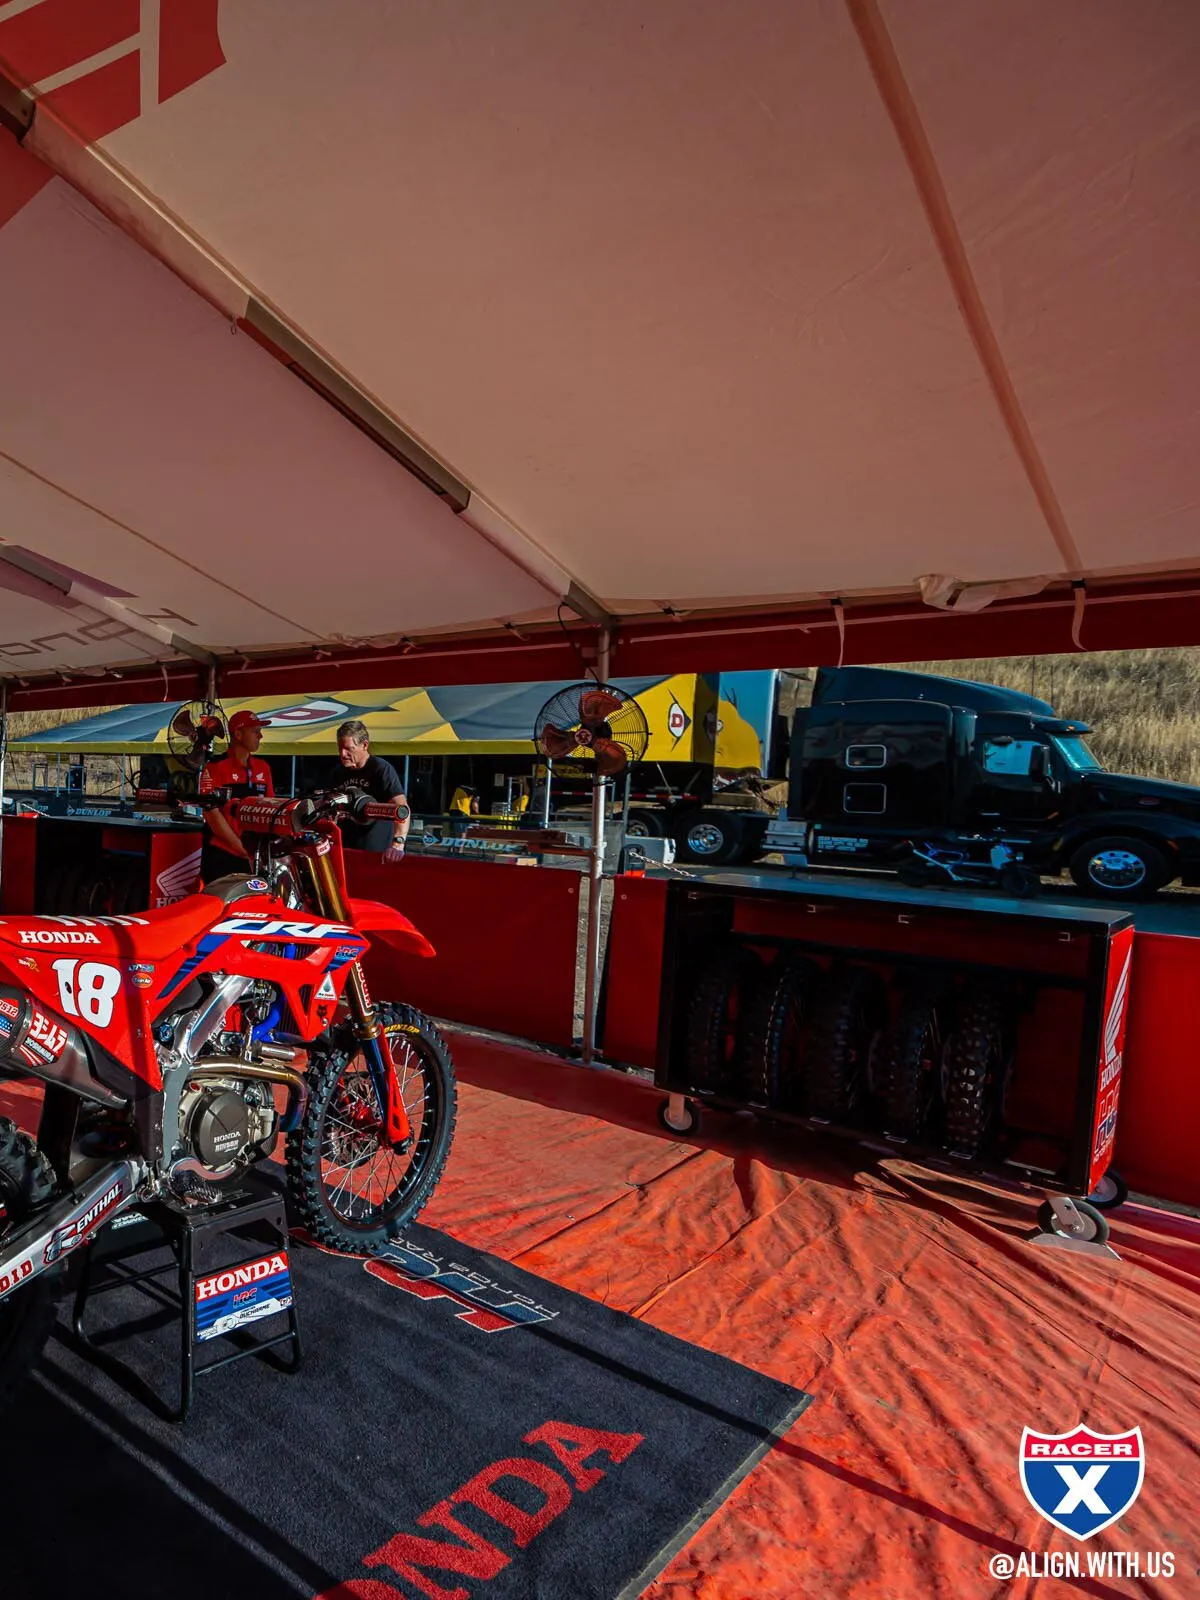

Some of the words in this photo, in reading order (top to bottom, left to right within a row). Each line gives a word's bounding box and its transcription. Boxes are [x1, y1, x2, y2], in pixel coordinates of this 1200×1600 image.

[209, 919, 354, 939] CRF
[18, 931, 101, 944] HONDA
[52, 958, 121, 1028] 18
[384, 1023, 421, 1034] DUNLOP
[213, 1131, 241, 1144] HONDA
[196, 1256, 288, 1300] HONDA
